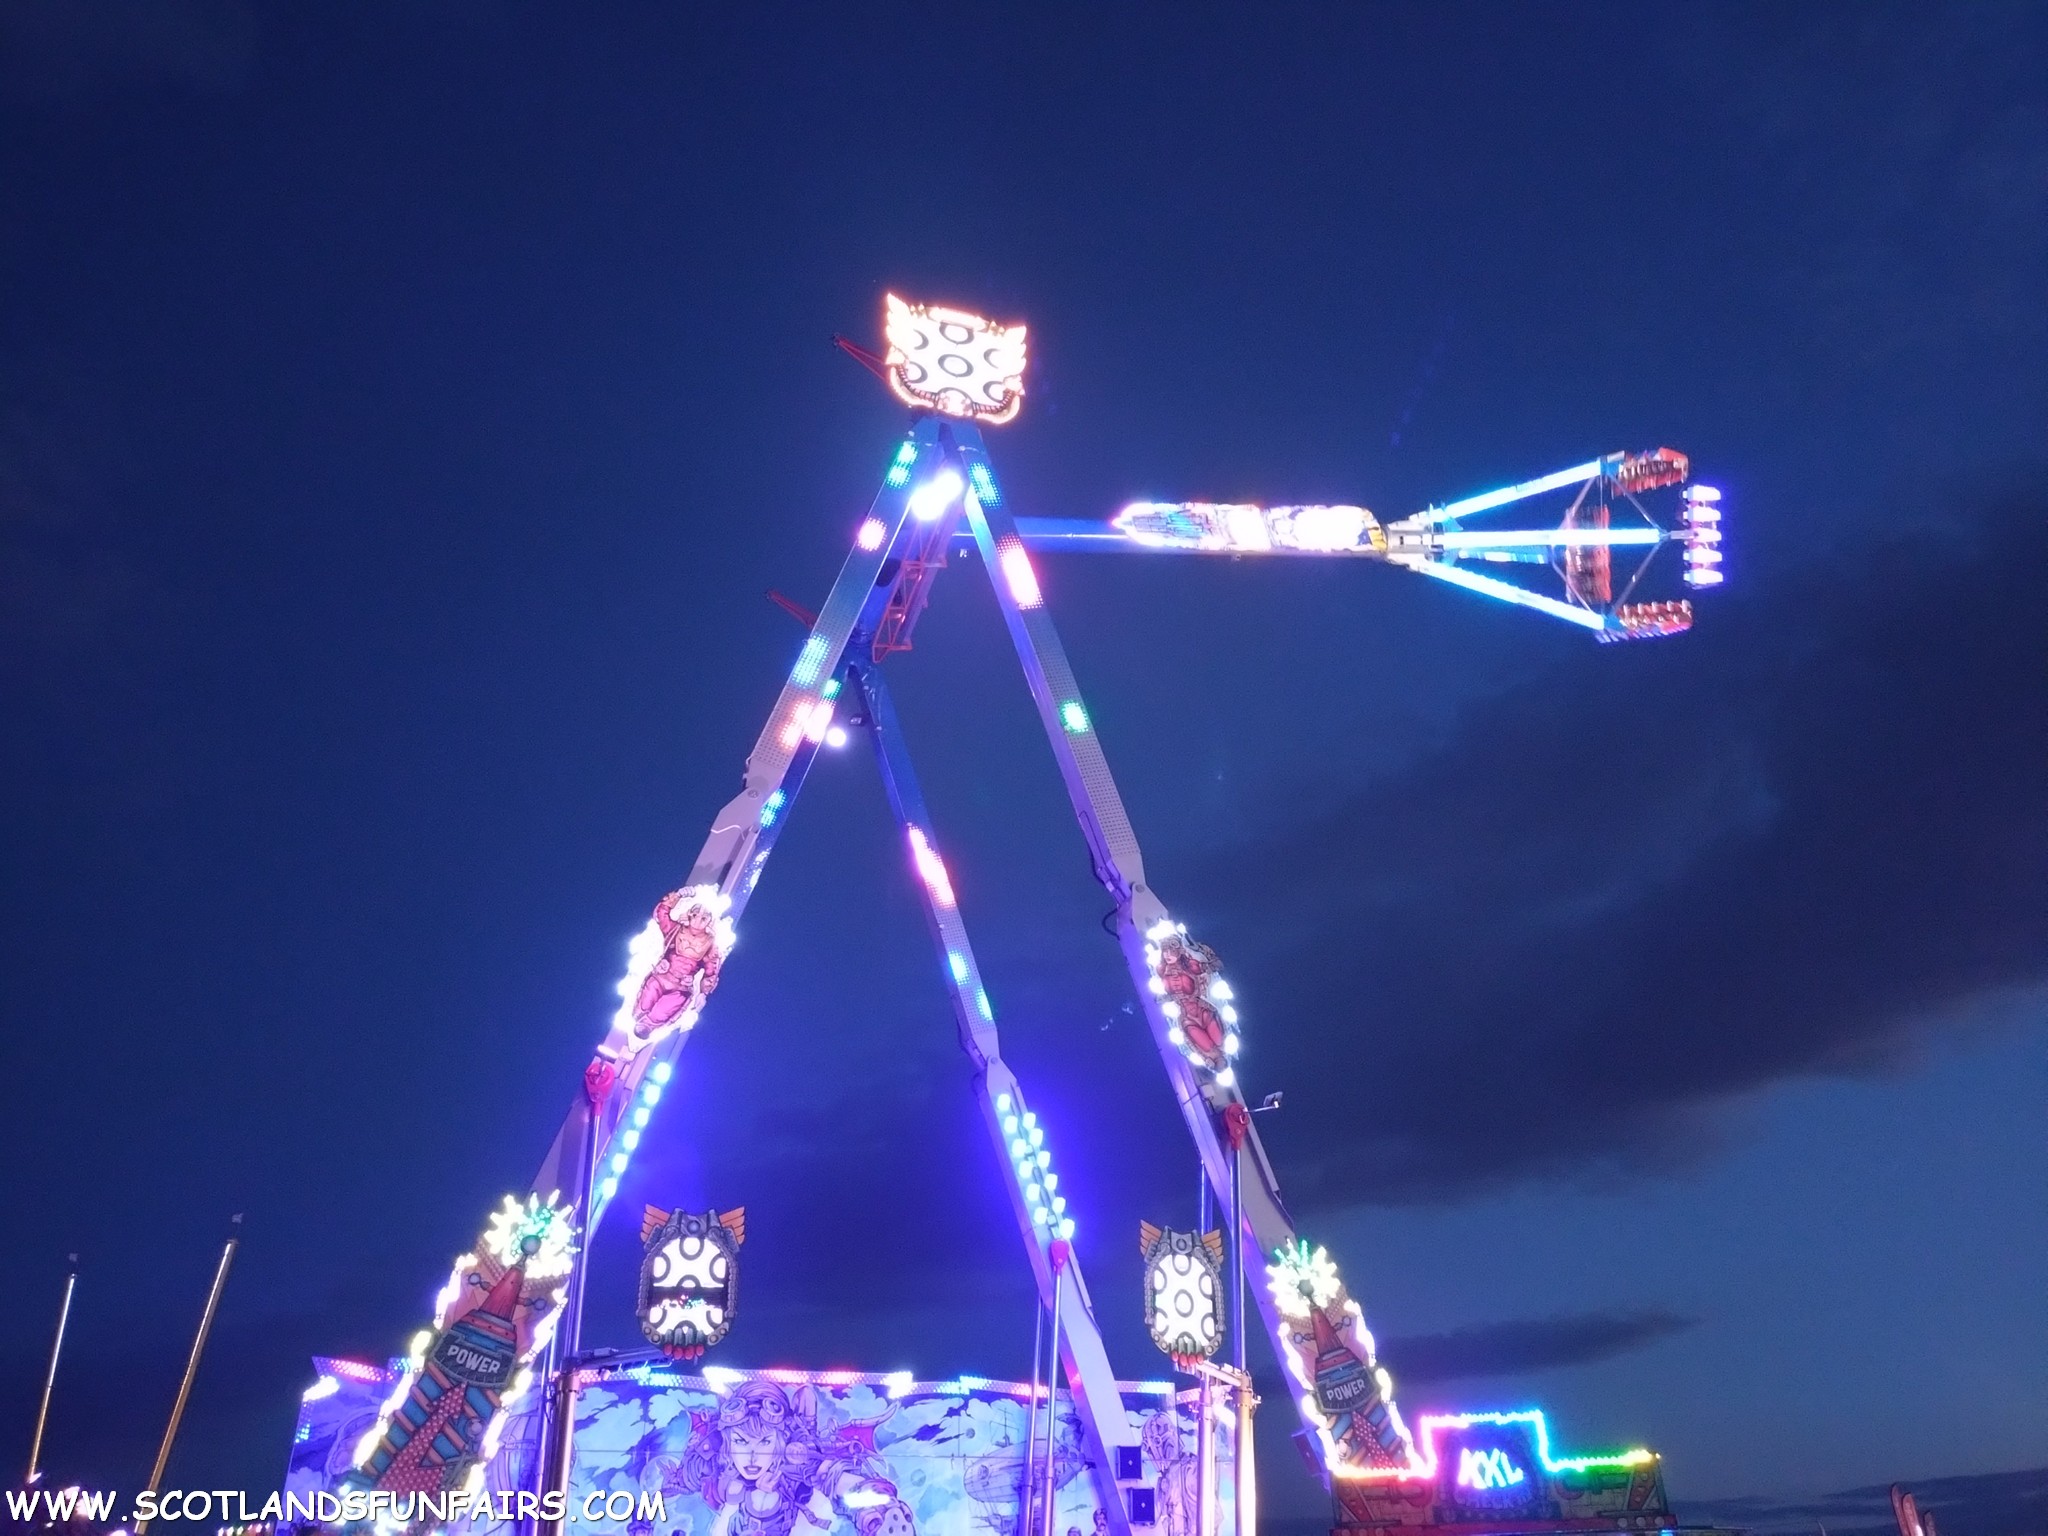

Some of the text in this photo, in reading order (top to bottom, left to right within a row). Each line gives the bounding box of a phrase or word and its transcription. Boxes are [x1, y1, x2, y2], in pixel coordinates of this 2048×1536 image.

[447, 1344, 501, 1374] POWER
[1326, 1378, 1366, 1401] POWER
[1457, 1447, 1524, 1490] XXL
